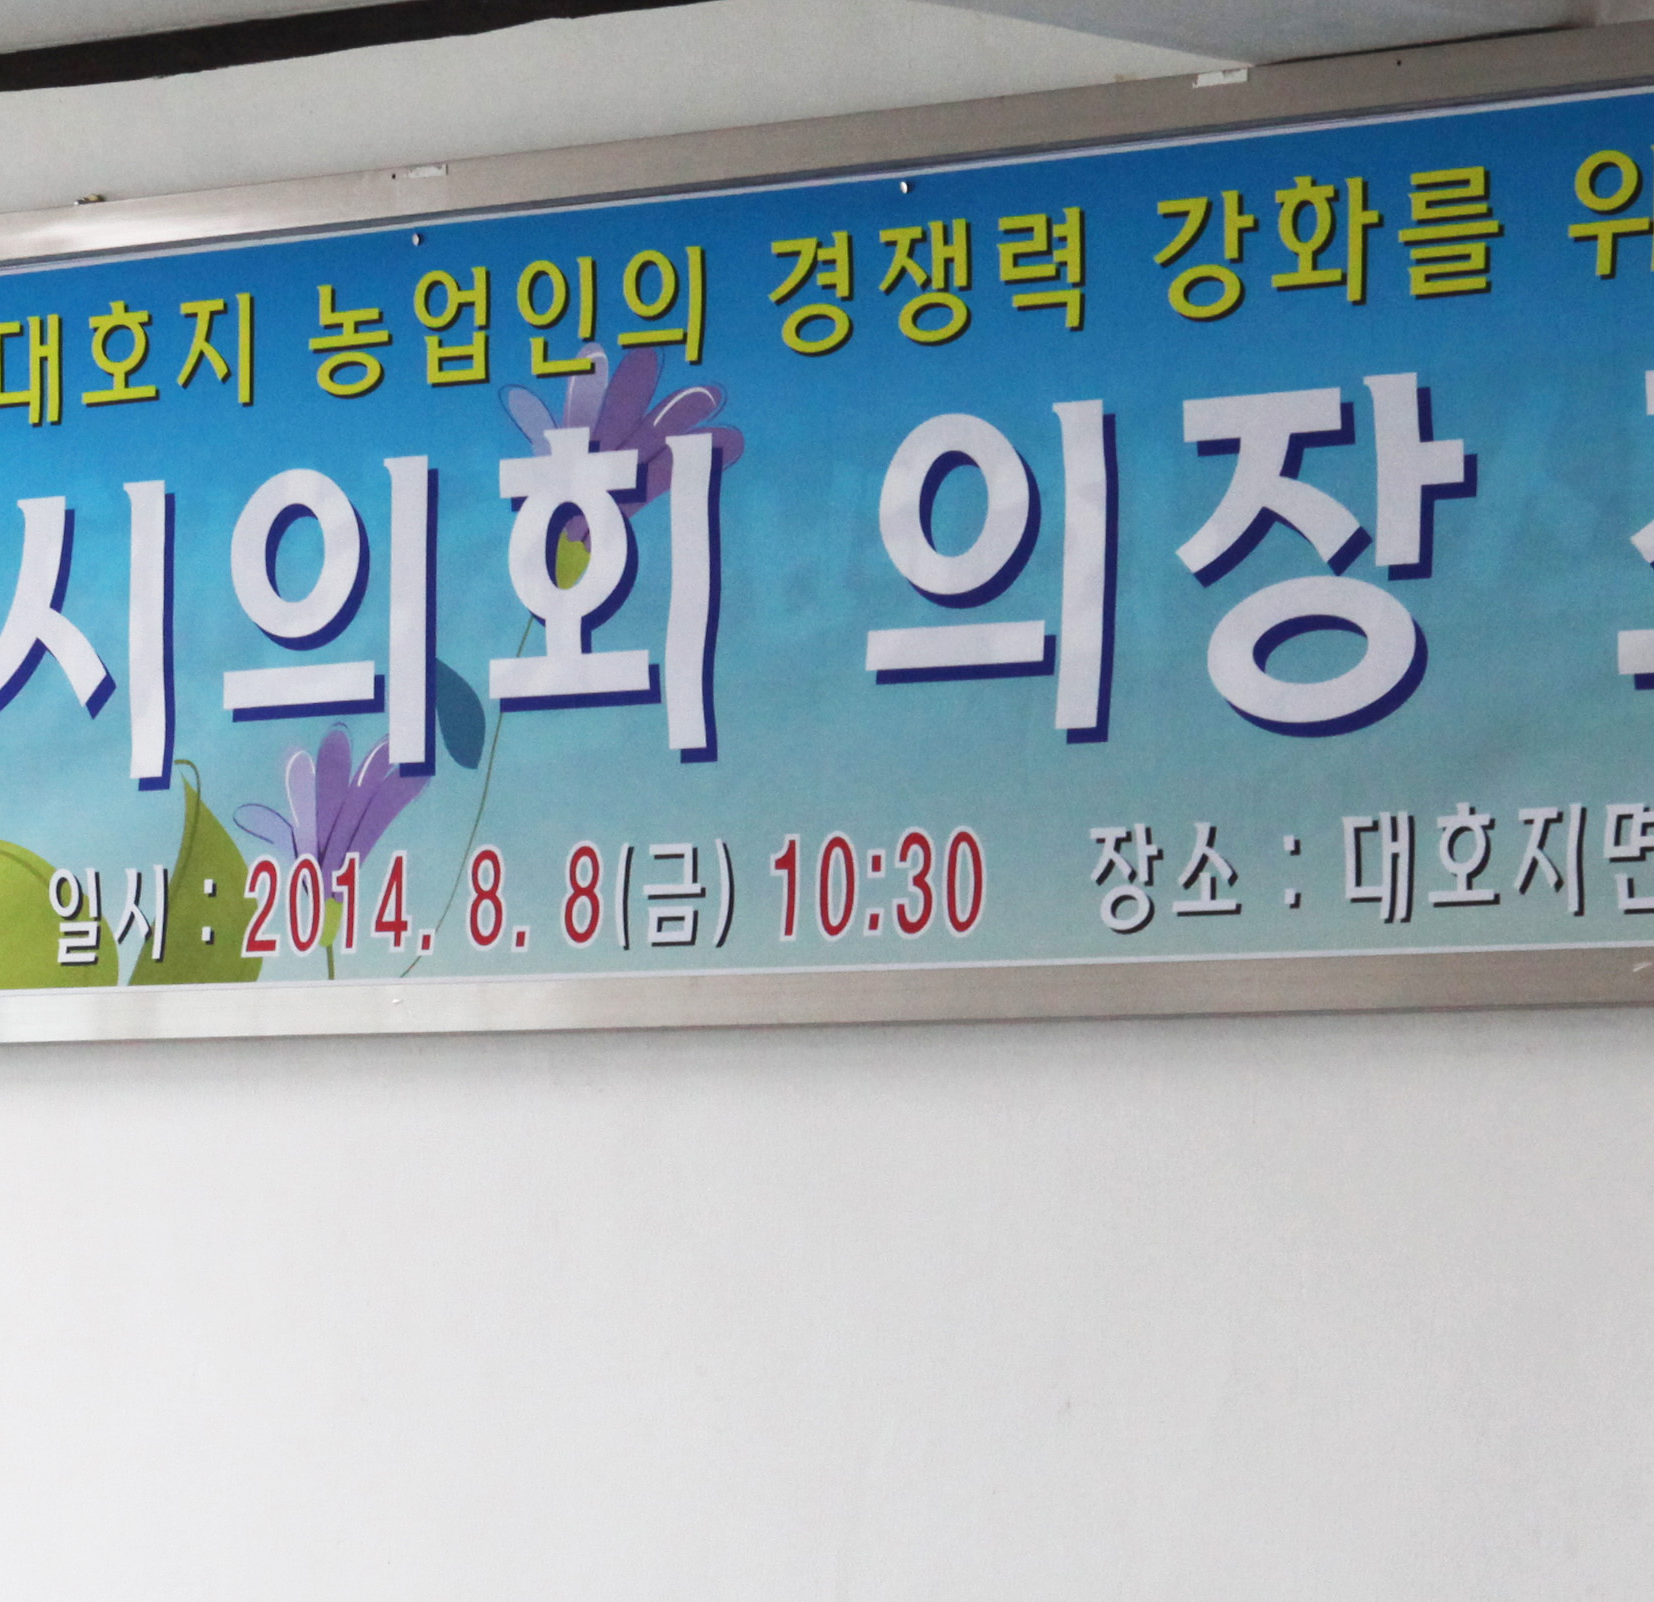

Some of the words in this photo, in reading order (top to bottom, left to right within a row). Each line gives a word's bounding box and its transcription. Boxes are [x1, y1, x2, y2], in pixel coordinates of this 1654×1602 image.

[309, 245, 705, 398] 농업인의
[767, 218, 1084, 356] 경쟁력
[1153, 165, 1500, 320] 강화를
[864, 371, 1476, 738] 의장
[49, 864, 168, 963] 일시
[242, 849, 438, 958] 2014.
[466, 843, 532, 954] 8.
[562, 840, 736, 949] 8(금)
[769, 825, 985, 944] 10:30
[1089, 820, 1243, 934] 장소
